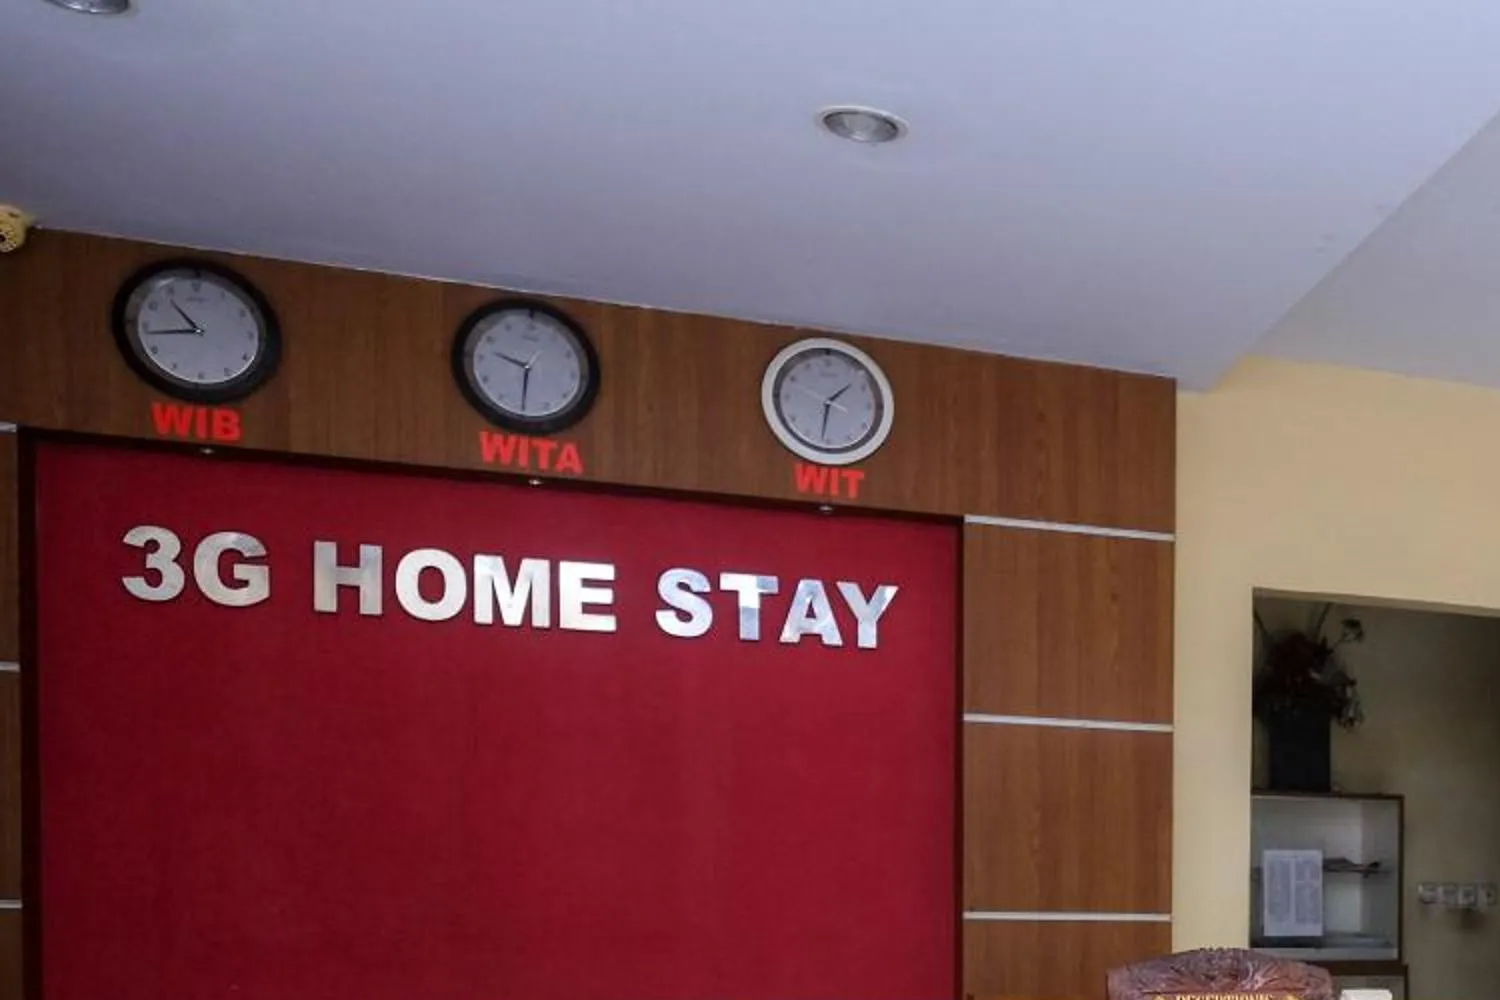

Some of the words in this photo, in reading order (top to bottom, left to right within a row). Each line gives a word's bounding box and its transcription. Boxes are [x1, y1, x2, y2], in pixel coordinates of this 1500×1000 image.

[153, 402, 243, 441] WIB
[479, 431, 584, 474] WITA
[794, 464, 865, 498] WIT
[122, 525, 271, 607] 3G
[313, 541, 618, 634] HOME
[655, 567, 899, 650] STAY
